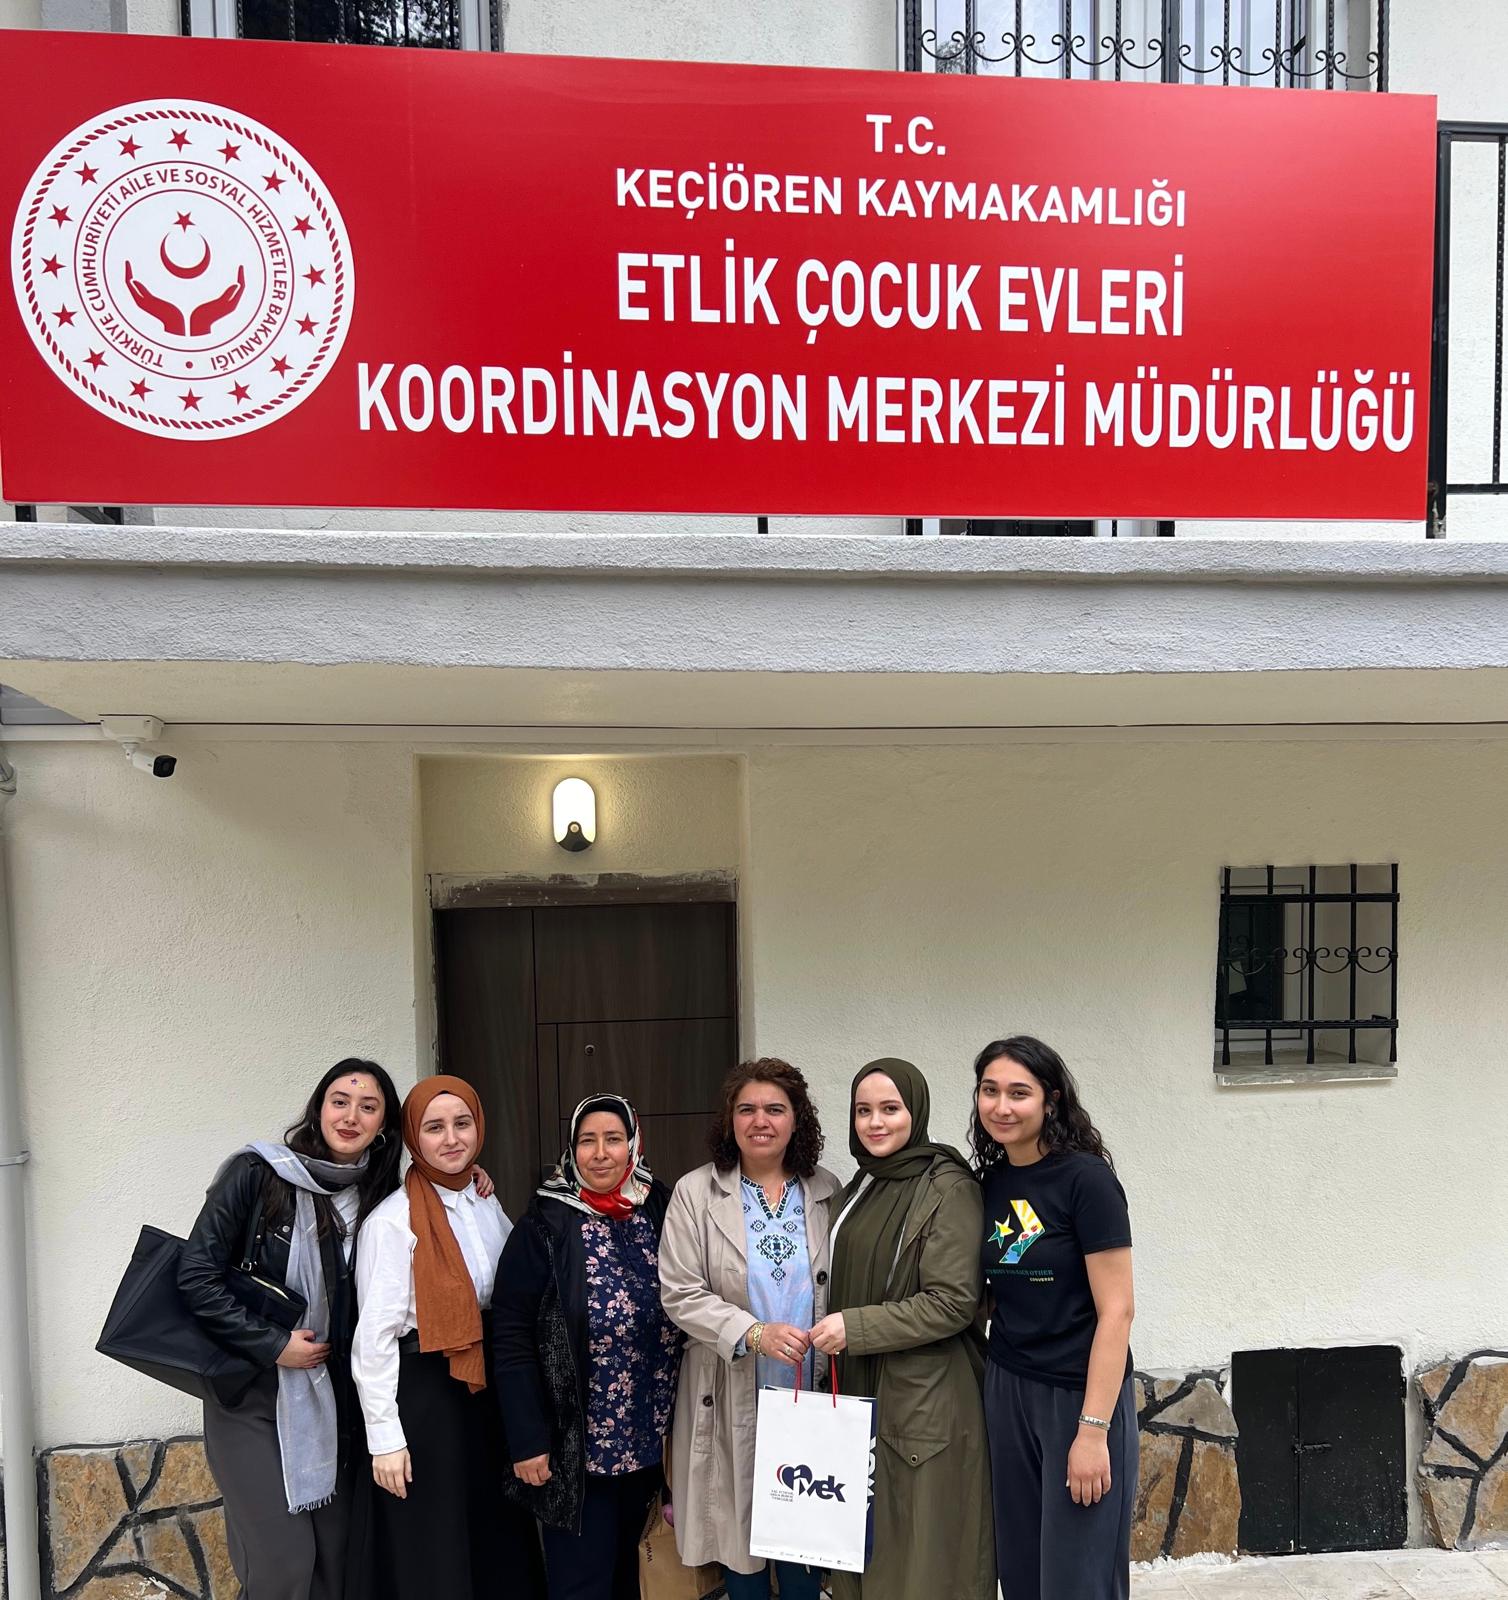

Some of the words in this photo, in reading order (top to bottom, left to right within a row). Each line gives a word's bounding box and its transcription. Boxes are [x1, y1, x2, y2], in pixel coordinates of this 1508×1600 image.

[865, 114, 946, 156] T.C.
[118, 173, 156, 200] AİLE
[156, 168, 180, 184] VE
[184, 168, 247, 208] SOSYAL
[616, 162, 842, 220] KEÇİÖREN
[858, 177, 1186, 228] KAYMAKAMLIĞI
[82, 191, 120, 311] CUMHURİYETİ
[247, 204, 288, 300] HİZMETLER
[617, 238, 781, 325] ETLİK
[796, 258, 982, 345] ÇOCUK
[999, 253, 1184, 337] EVLERİ
[99, 313, 164, 369] TÜRKİYE
[209, 303, 283, 372] BAKANLIĞI
[357, 350, 807, 441] KOORDİNASYON
[828, 364, 1065, 446] MERKEZİ
[1085, 365, 1415, 453] MÜDÜRLÜĞÜ
